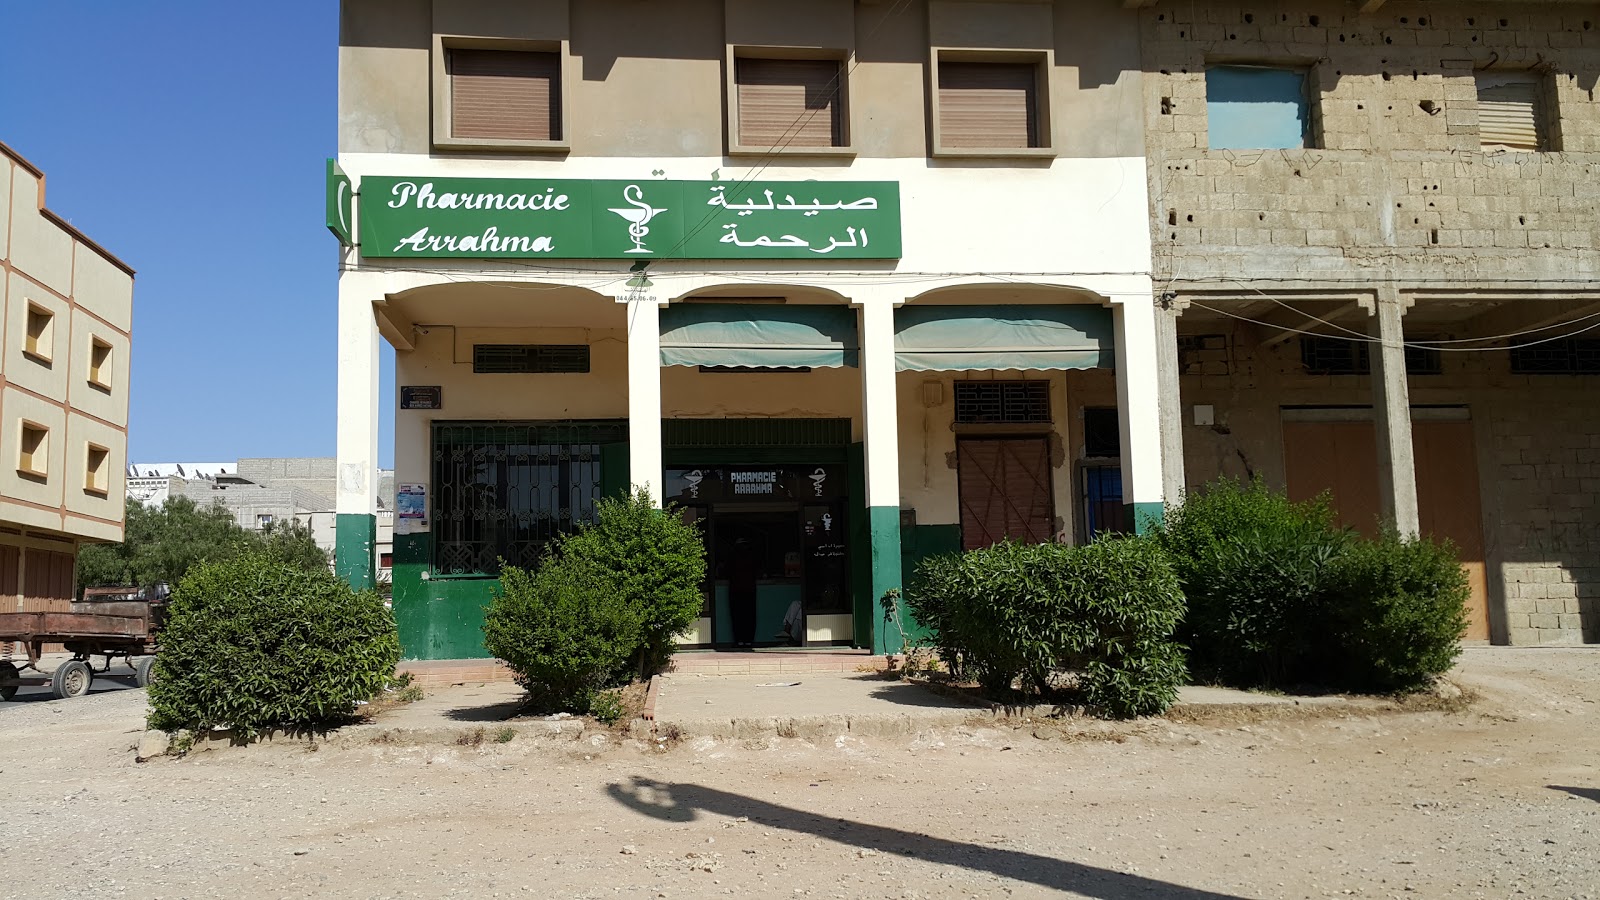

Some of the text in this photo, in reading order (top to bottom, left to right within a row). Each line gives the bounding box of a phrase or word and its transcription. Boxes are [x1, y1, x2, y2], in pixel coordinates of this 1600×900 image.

[388, 182, 570, 210] Pharmacie
[707, 185, 878, 217] صيدلية
[393, 226, 555, 252] Arrahma
[719, 223, 868, 253] الرحمة
[731, 472, 776, 482] PHARMACIE
[735, 483, 772, 494] ARRAHMA
